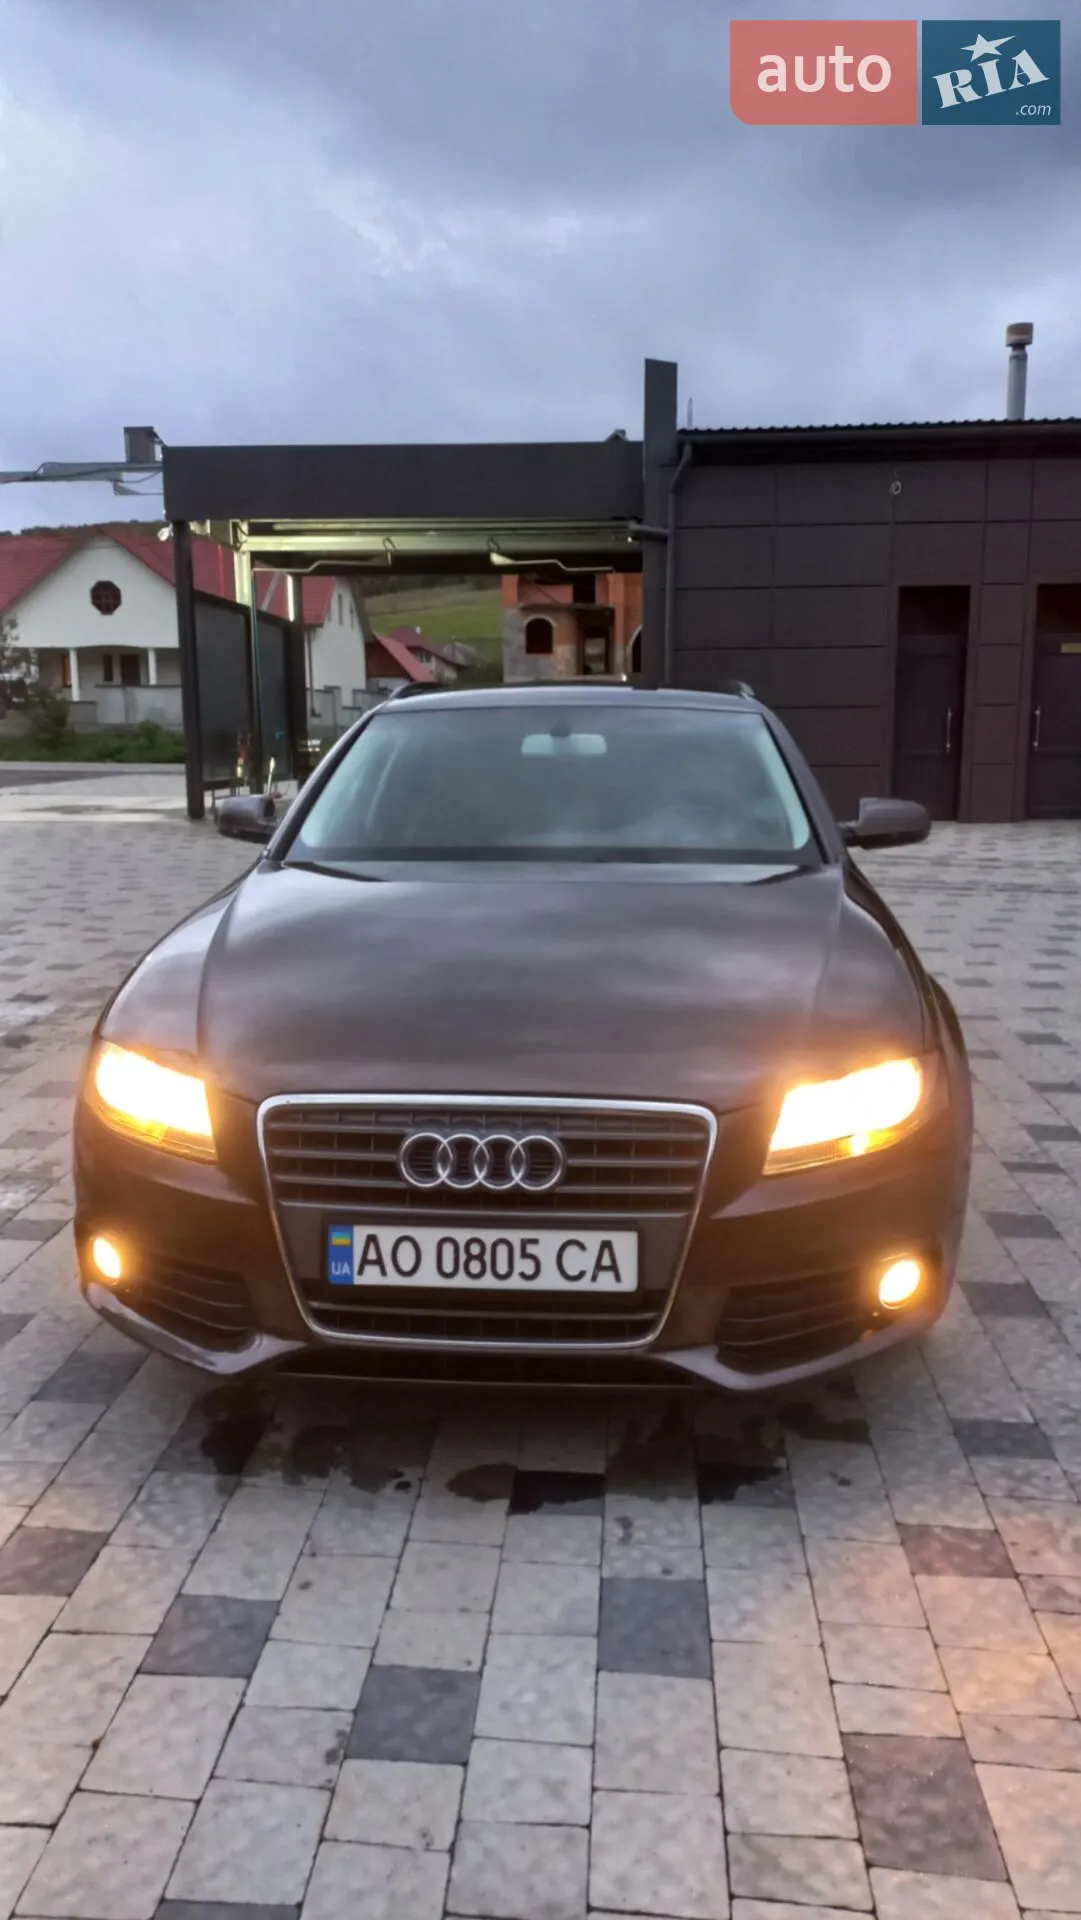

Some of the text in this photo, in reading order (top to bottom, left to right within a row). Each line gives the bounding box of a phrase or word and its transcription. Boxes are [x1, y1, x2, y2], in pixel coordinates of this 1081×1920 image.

[331, 1262, 351, 1276] UA
[357, 1234, 622, 1283] AO 0805 CA
